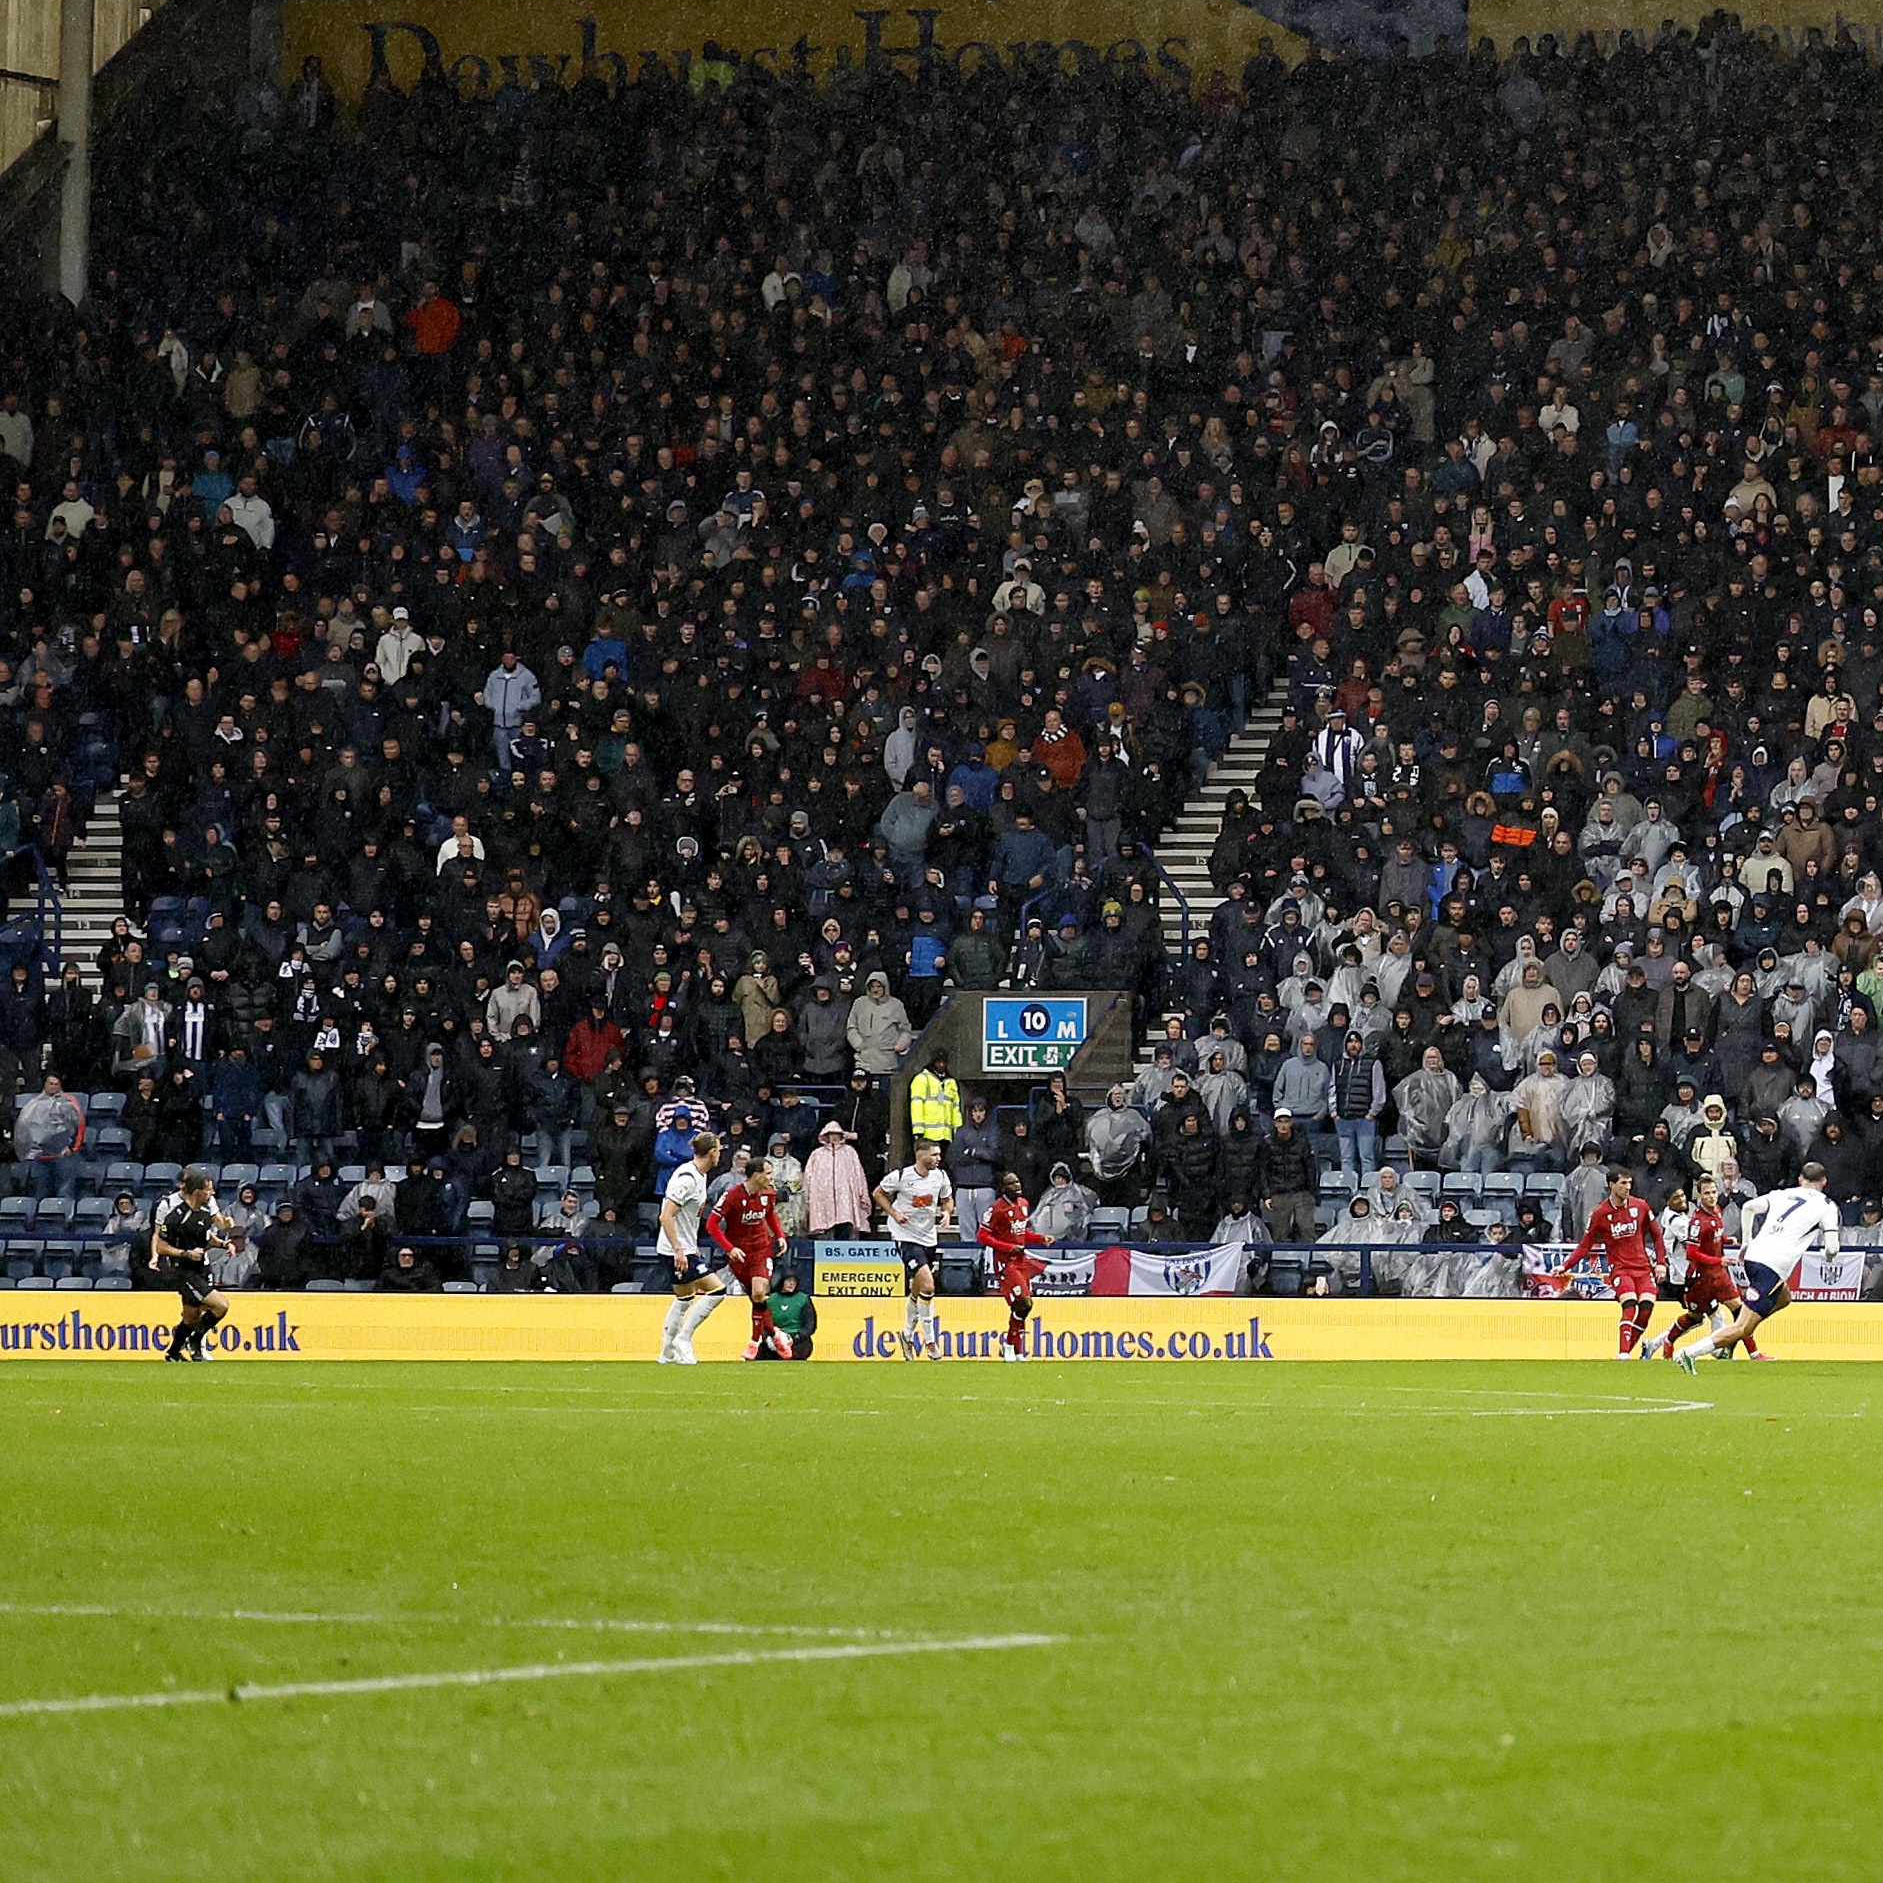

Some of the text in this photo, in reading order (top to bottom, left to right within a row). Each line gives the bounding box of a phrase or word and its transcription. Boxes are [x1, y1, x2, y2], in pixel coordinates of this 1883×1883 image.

[998, 1011, 1076, 1038] L 10 M
[990, 1046, 1037, 1064] EXIT
[741, 1209, 767, 1223] ideal
[1777, 1197, 1807, 1222] 7
[825, 1248, 897, 1257] BS. GATE 10
[822, 1273, 900, 1282] EMERGENCY
[828, 1287, 894, 1295] EXIT ONLY
[0, 1309, 300, 1351] ursthomeco.uk
